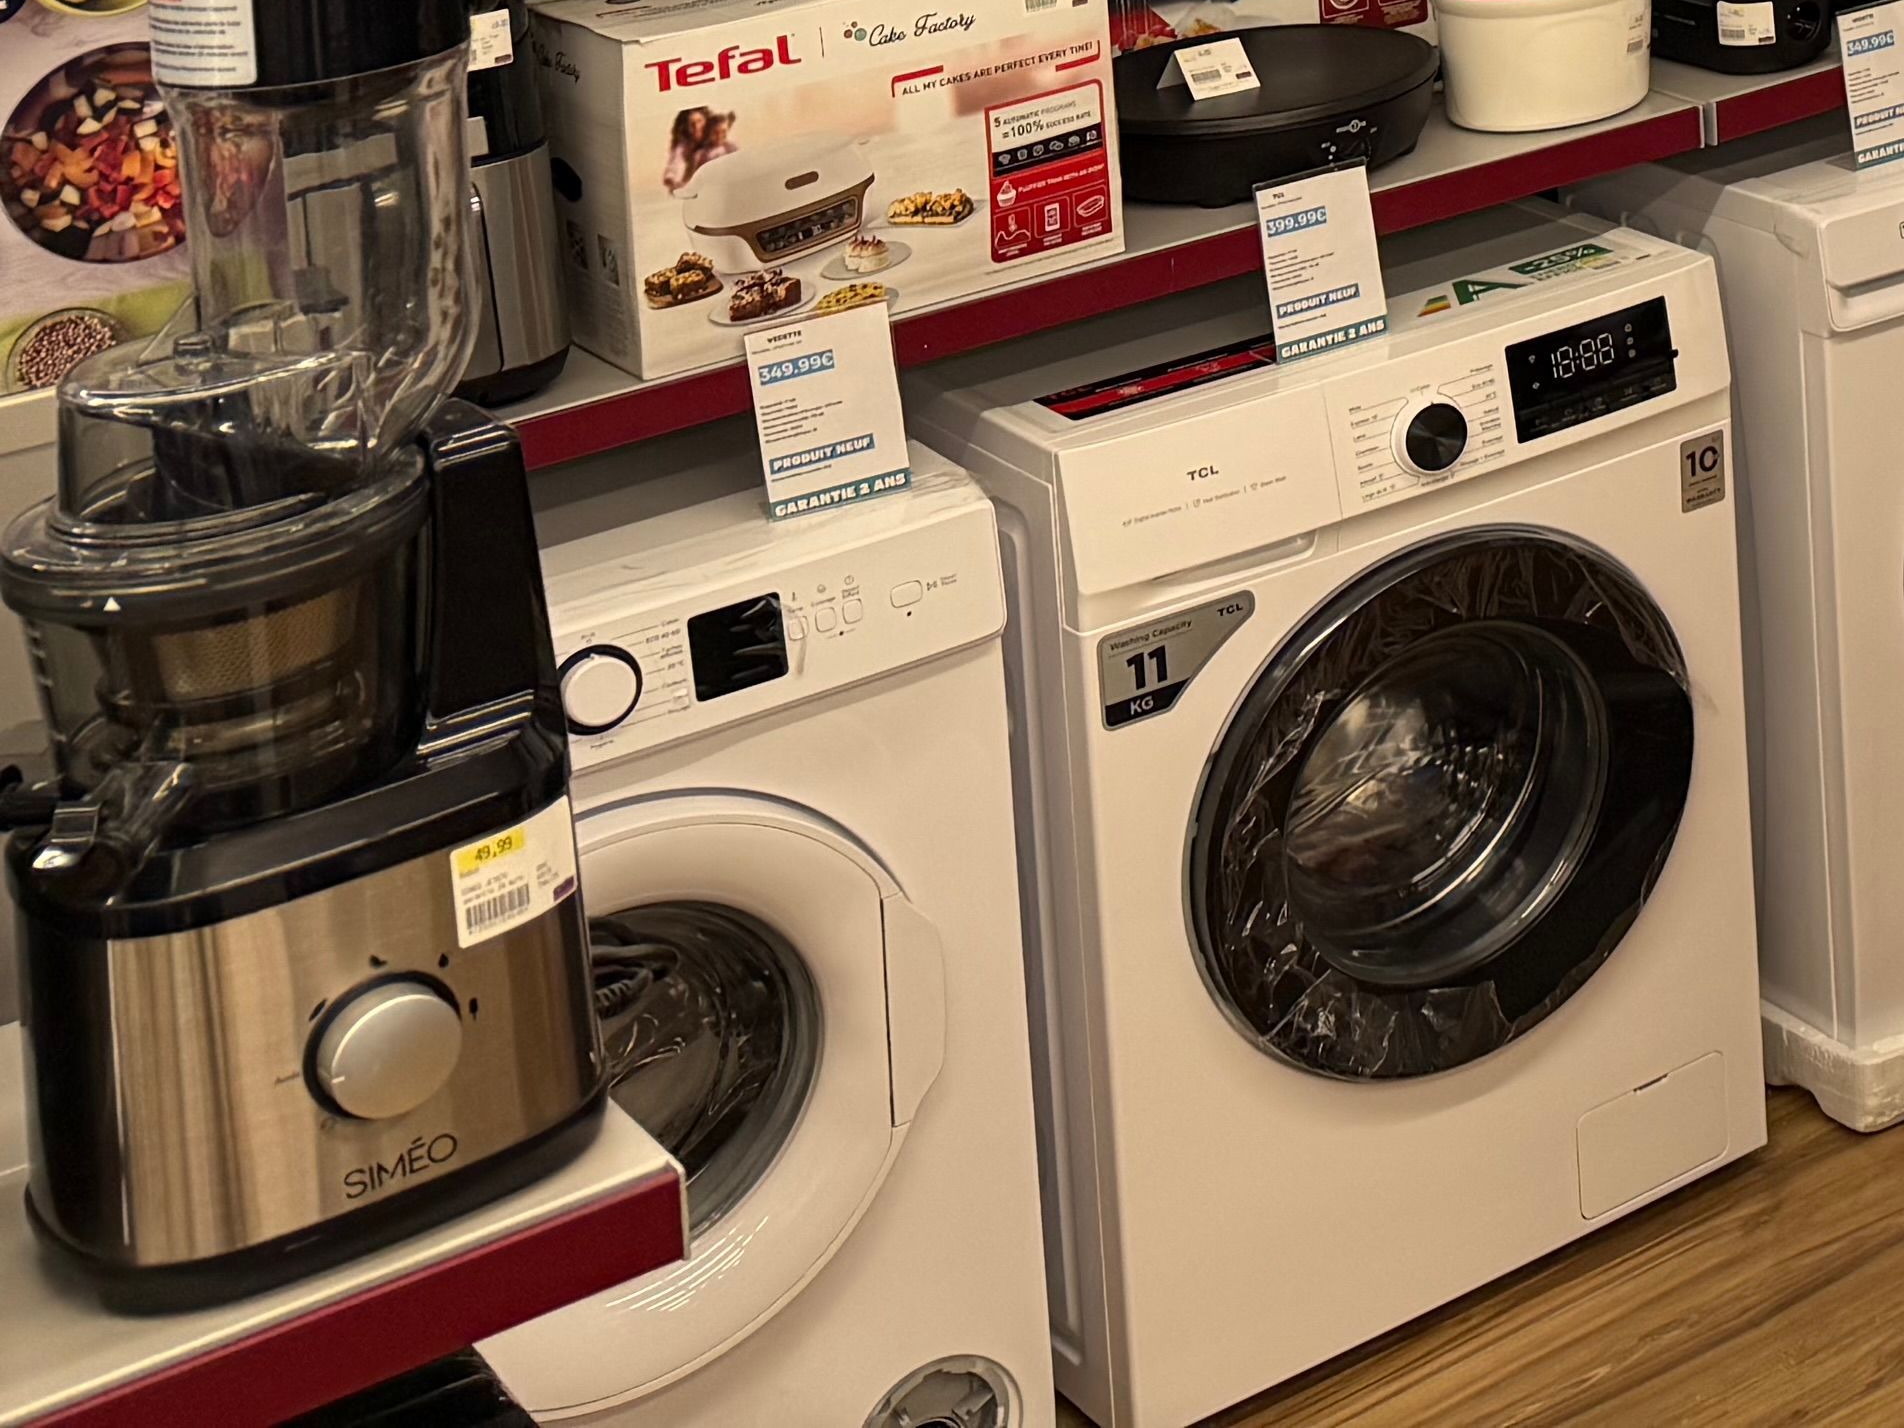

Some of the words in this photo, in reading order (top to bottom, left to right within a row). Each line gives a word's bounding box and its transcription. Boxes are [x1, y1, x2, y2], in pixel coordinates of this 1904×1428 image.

[868, 20, 910, 47] Cake
[914, 10, 977, 40] Factory
[646, 37, 802, 92] Tefal
[902, 85, 920, 96] ALL
[923, 81, 937, 91] MY
[940, 73, 971, 87] CAKES
[974, 67, 992, 79] ARE
[994, 57, 1036, 74] PERFECT
[1038, 50, 1067, 64] EVERY
[1070, 42, 1093, 55] TIME!
[1267, 208, 1327, 235] 399.99€
[759, 352, 833, 383] 349.99€
[773, 446, 832, 471] PRODUIT
[835, 437, 871, 457] NEUF
[1685, 446, 1719, 473] 10
[775, 490, 856, 518] GARANTIE
[860, 483, 870, 495] 2
[874, 473, 905, 491] ANS
[1126, 645, 1168, 690] 11
[1129, 695, 1153, 715] KG
[475, 836, 513, 861] 49,99
[345, 1134, 458, 1199] SIMÉO
